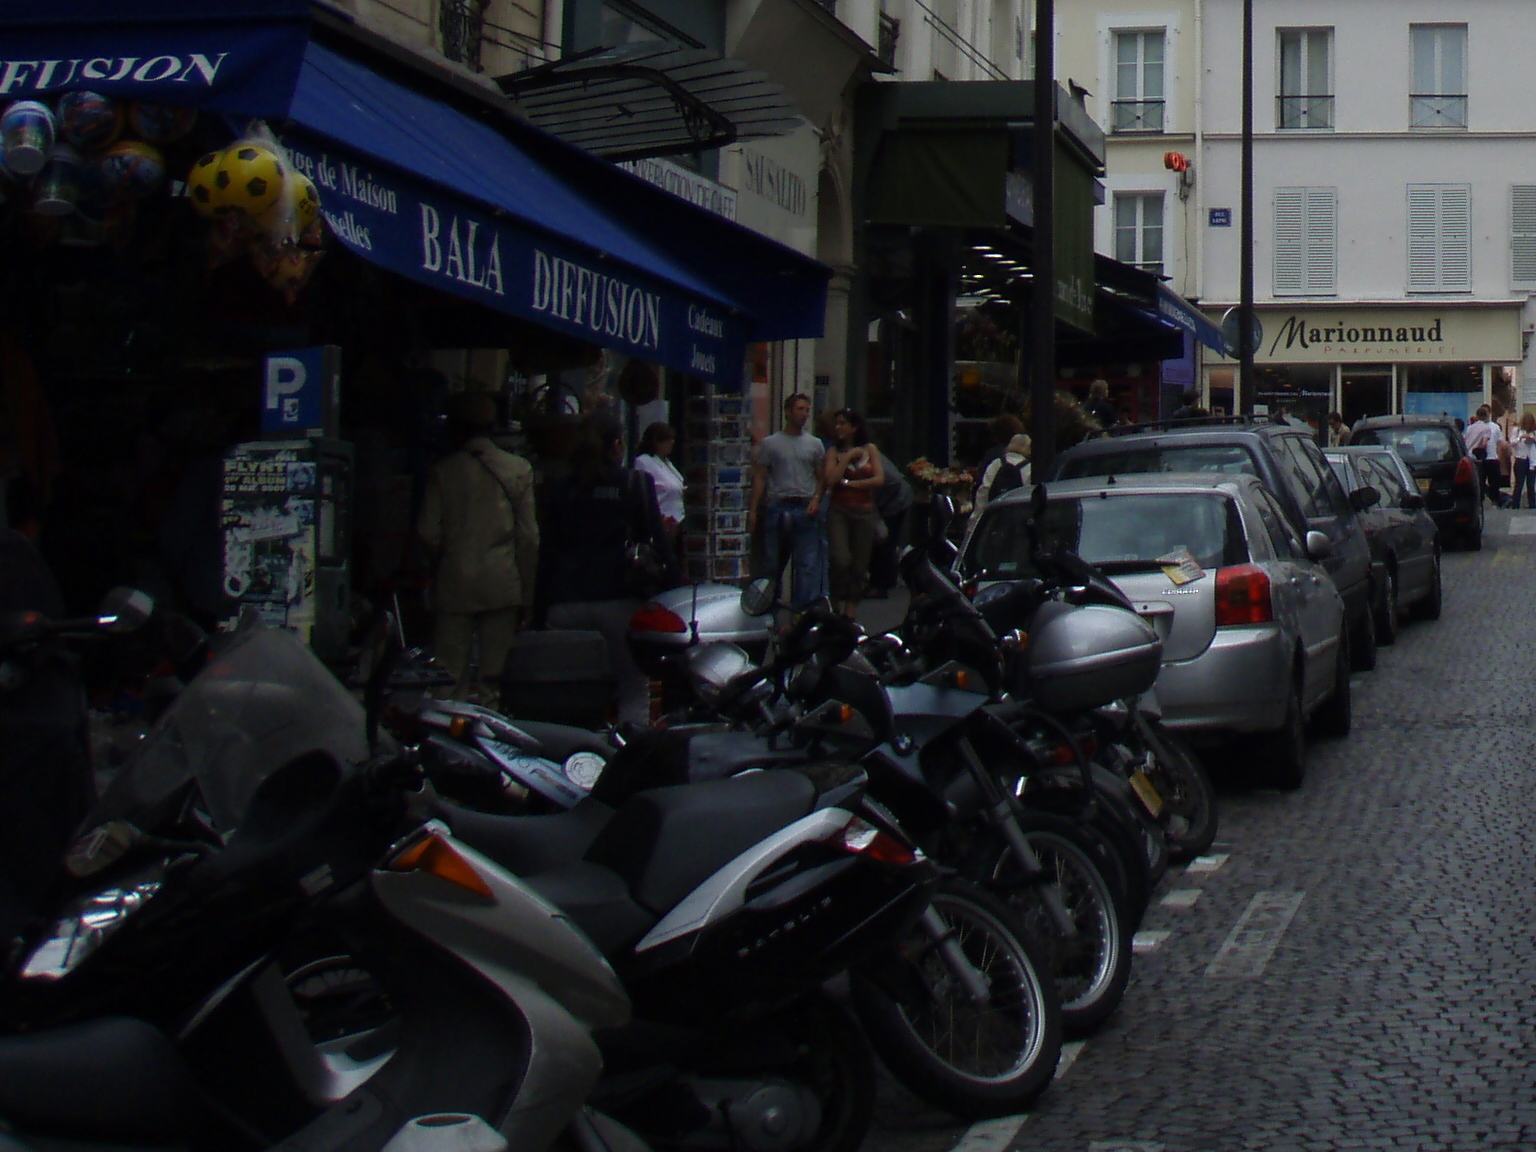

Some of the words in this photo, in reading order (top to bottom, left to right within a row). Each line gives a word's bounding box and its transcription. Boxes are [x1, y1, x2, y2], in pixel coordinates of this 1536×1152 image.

[317, 154, 338, 191] de
[341, 162, 398, 215] Maison
[420, 202, 505, 295] BALA
[531, 248, 661, 349] DIFFUSION
[688, 304, 724, 338] Cadeaux
[1269, 315, 1443, 357] Marionnaud
[266, 357, 307, 410] P
